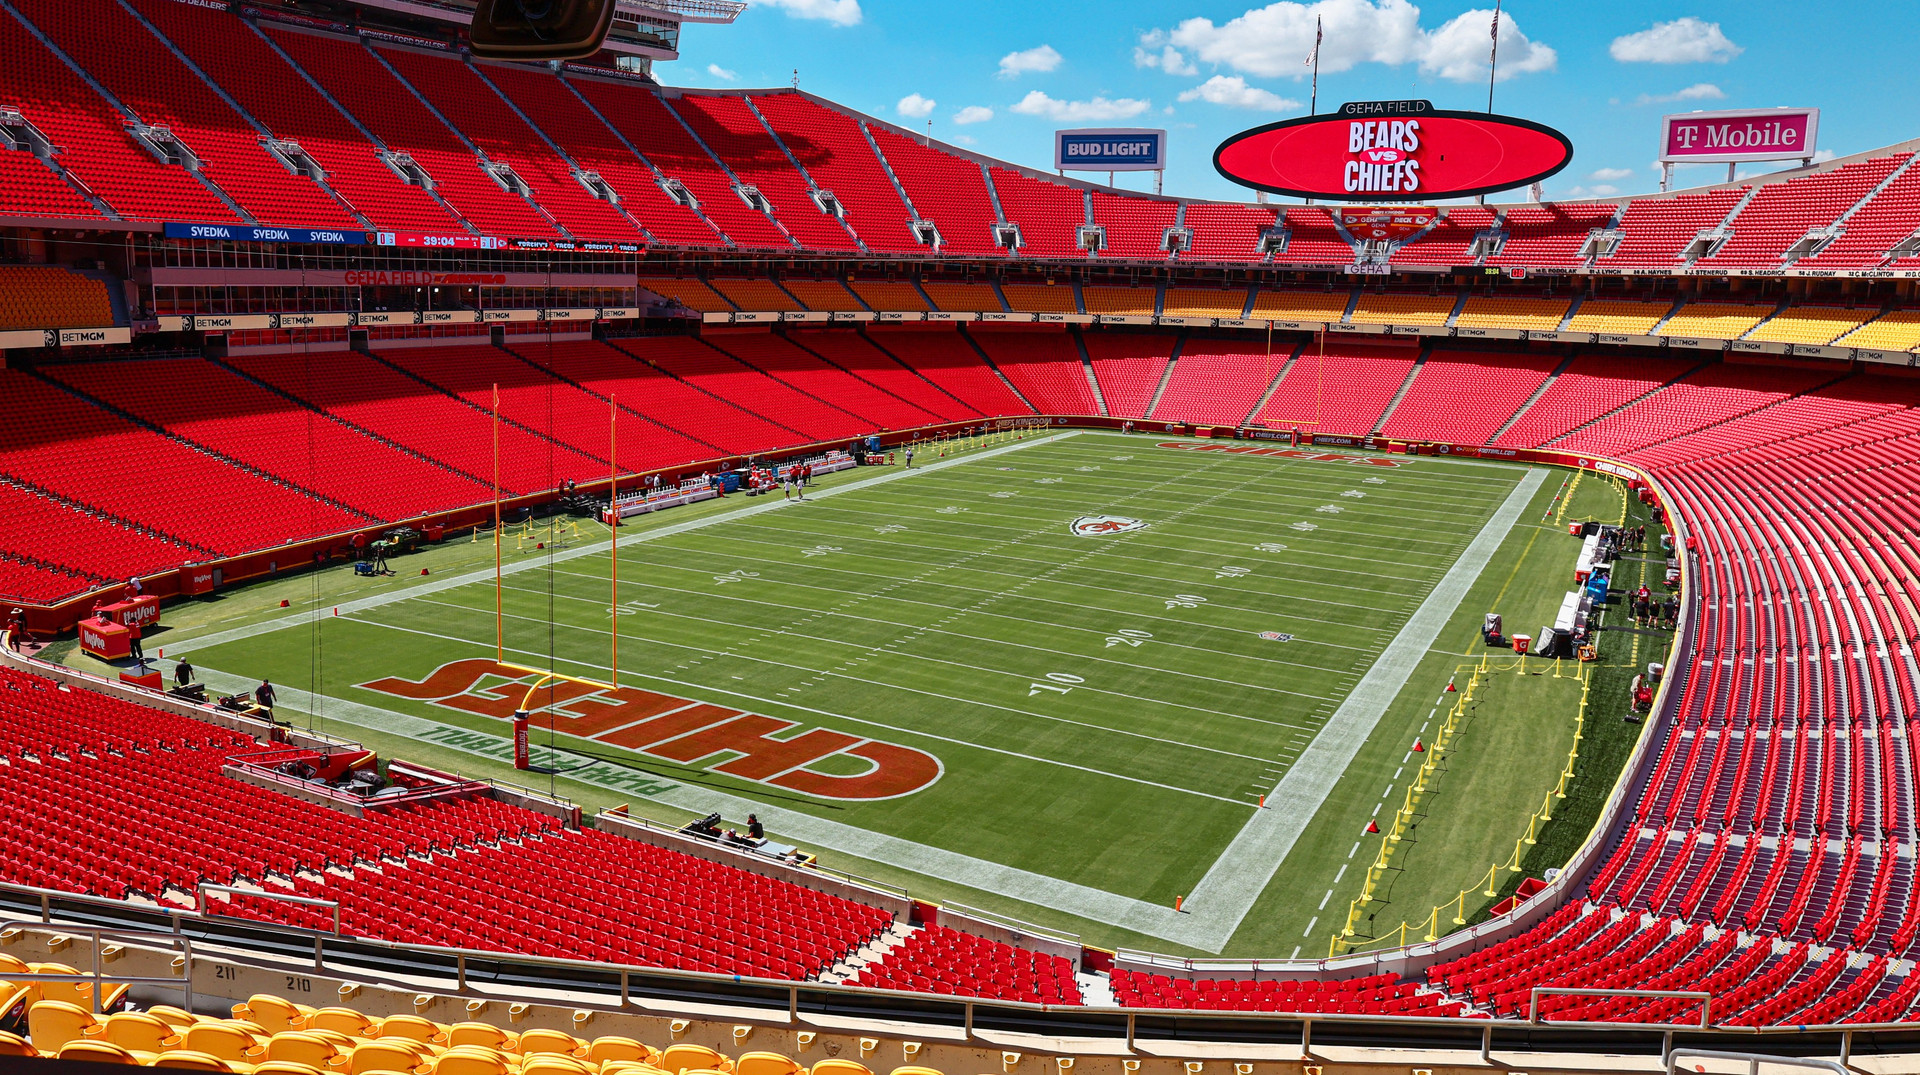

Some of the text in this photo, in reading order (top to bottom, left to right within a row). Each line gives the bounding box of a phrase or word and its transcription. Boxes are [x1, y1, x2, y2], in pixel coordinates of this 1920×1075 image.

[359, 29, 393, 40] MIDWEST
[1346, 101, 1425, 114] GEHA FIELD
[1349, 120, 1419, 153] BEARS
[1704, 123, 1797, 147] Mobile
[1068, 143, 1150, 156] BUD LIGHT
[1368, 151, 1398, 161] VS
[1344, 160, 1419, 192] CHIEFS
[191, 226, 344, 242] SVEDKA SVEDKA SVEDKA
[424, 236, 455, 246] 39:04
[1351, 265, 1384, 273] GEHA
[1512, 269, 1523, 277] 08
[345, 271, 389, 285] GEHA
[392, 272, 432, 285] FIELD
[197, 319, 231, 327] BETMGM
[282, 316, 314, 325] BETMGM
[62, 332, 105, 342] BETMGM
[1795, 346, 1820, 354] BETMGM
[1859, 351, 1882, 359] BETMGM
[1595, 461, 1616, 473] CHIEFS
[1165, 594, 1207, 609] 30
[1105, 629, 1153, 647] 20
[1519, 641, 1527, 649] G
[1031, 672, 1085, 695] 10
[351, 658, 945, 802] CHIEFS
[519, 730, 528, 758] FOOTBALL
[215, 965, 235, 980] 211
[286, 976, 311, 992] 210
